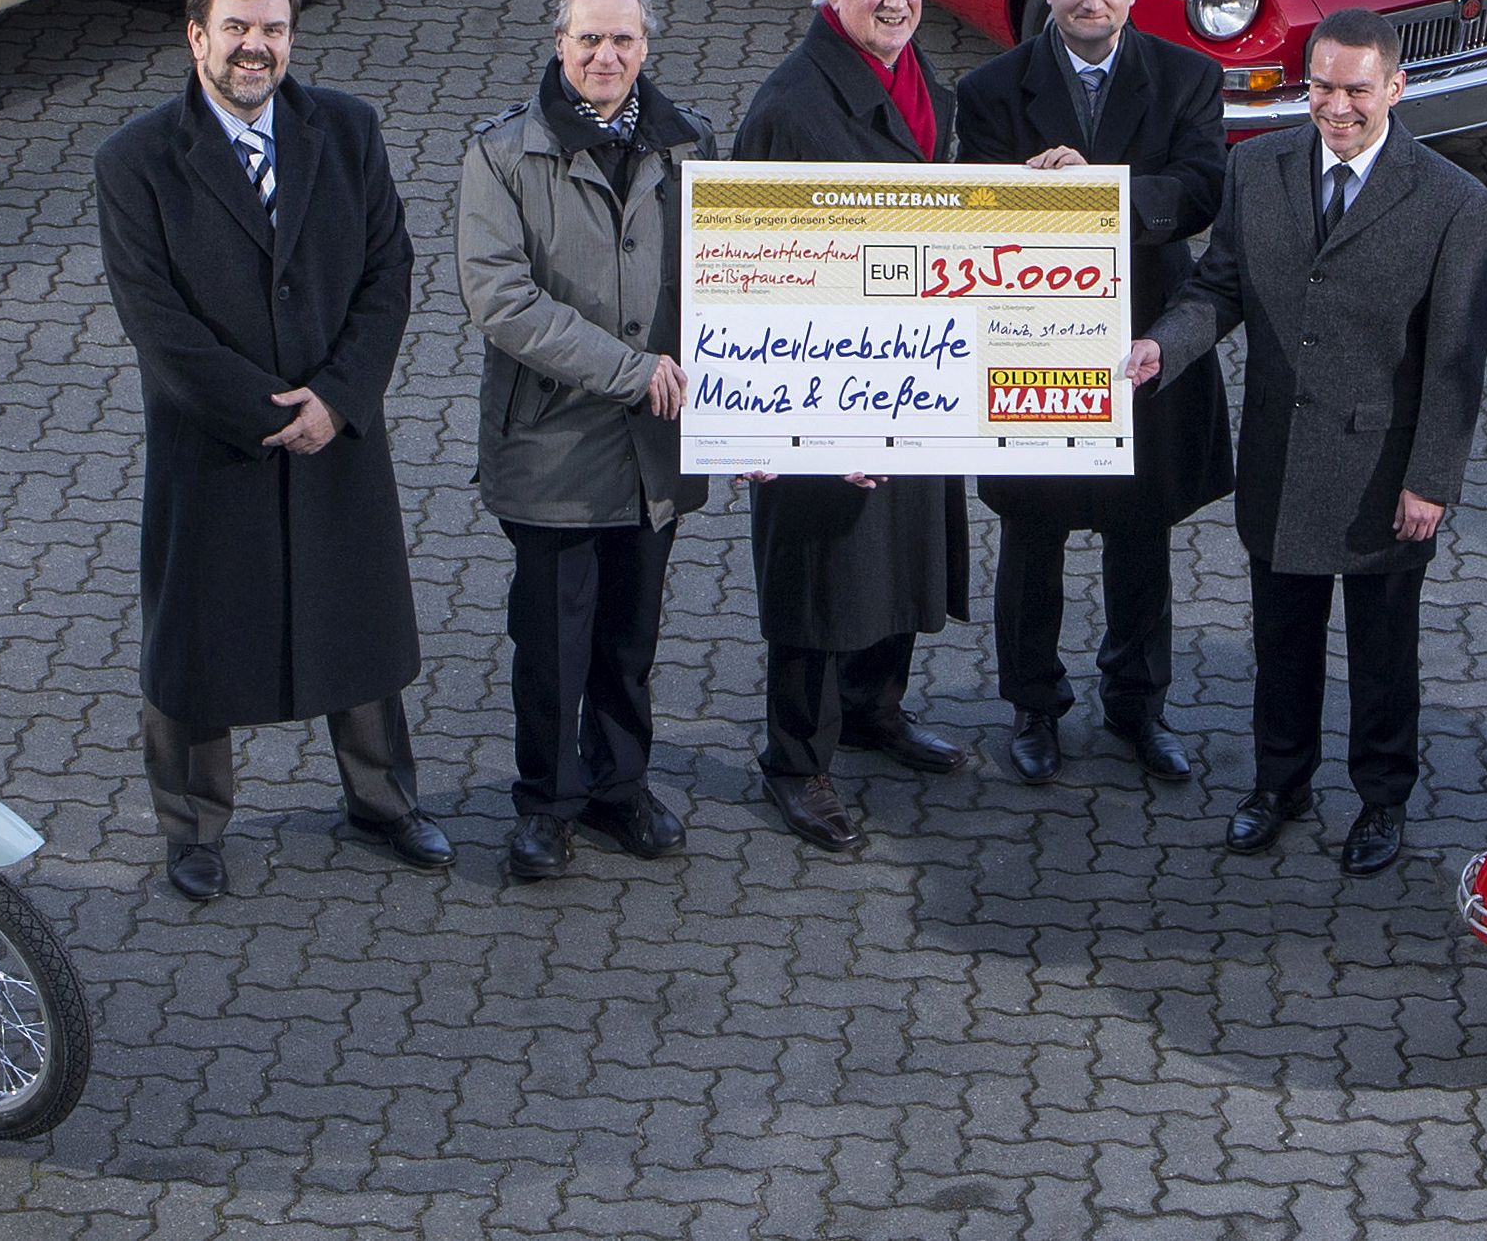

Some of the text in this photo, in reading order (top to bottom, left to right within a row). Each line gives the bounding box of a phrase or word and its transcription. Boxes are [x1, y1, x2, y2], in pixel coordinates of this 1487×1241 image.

[812, 192, 961, 206] COMMERZBANK
[695, 215, 867, 226] Zahlen Sie gegen diesen Scheck
[1100, 218, 1116, 227] DE
[695, 240, 861, 263] dreihundertfuenfund
[871, 264, 909, 280] EUR
[920, 244, 1121, 298] 335.000,-
[695, 270, 817, 293] dreißigtausend
[1040, 322, 1107, 337] 31.01.2014
[694, 318, 970, 370] Kinderkrebshilfe
[992, 371, 1107, 385] OLDTIMER
[694, 373, 959, 420] Mainz & Gießen
[990, 388, 1109, 414] MARKT
